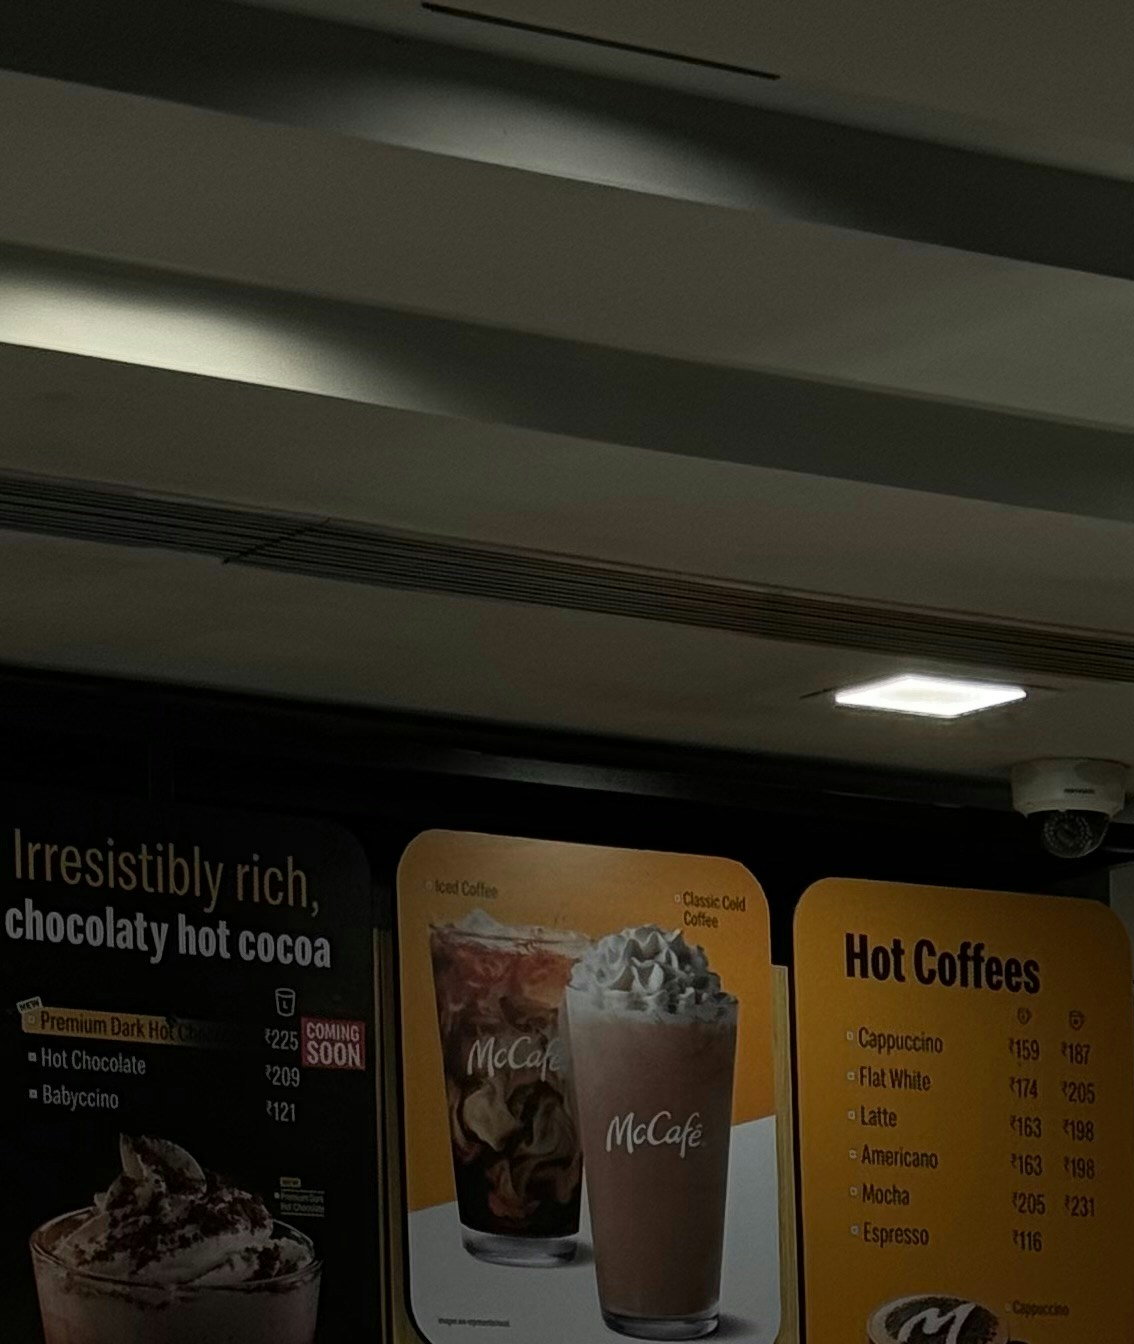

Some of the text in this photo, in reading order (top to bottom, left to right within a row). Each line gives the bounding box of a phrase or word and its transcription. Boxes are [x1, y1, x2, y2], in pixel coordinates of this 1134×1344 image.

[15, 828, 320, 917] Irresistibly rich,
[435, 879, 498, 899] Iced Coffee
[683, 891, 746, 912] Classic Cold
[684, 910, 719, 928] Coffee
[5, 898, 331, 968] chocolaty hot cocoa
[846, 932, 1040, 993] Hot Coffees
[40, 1010, 107, 1035] Premium
[111, 1016, 145, 1040] Dark
[306, 1021, 360, 1043] COMING
[264, 1028, 299, 1052] ₹225
[858, 1027, 943, 1054] Cappuccino
[41, 1047, 147, 1076] Hot Chocolate
[306, 1041, 361, 1067] SOON
[265, 1065, 300, 1089] ₹209
[859, 1066, 931, 1091] Flat White
[42, 1084, 119, 1112] Babyccino
[265, 1100, 296, 1124] ₹121
[860, 1105, 897, 1129] Latte
[861, 1144, 938, 1169] Americano
[862, 1184, 910, 1206] Mocha
[863, 1222, 929, 1247] Espresso
